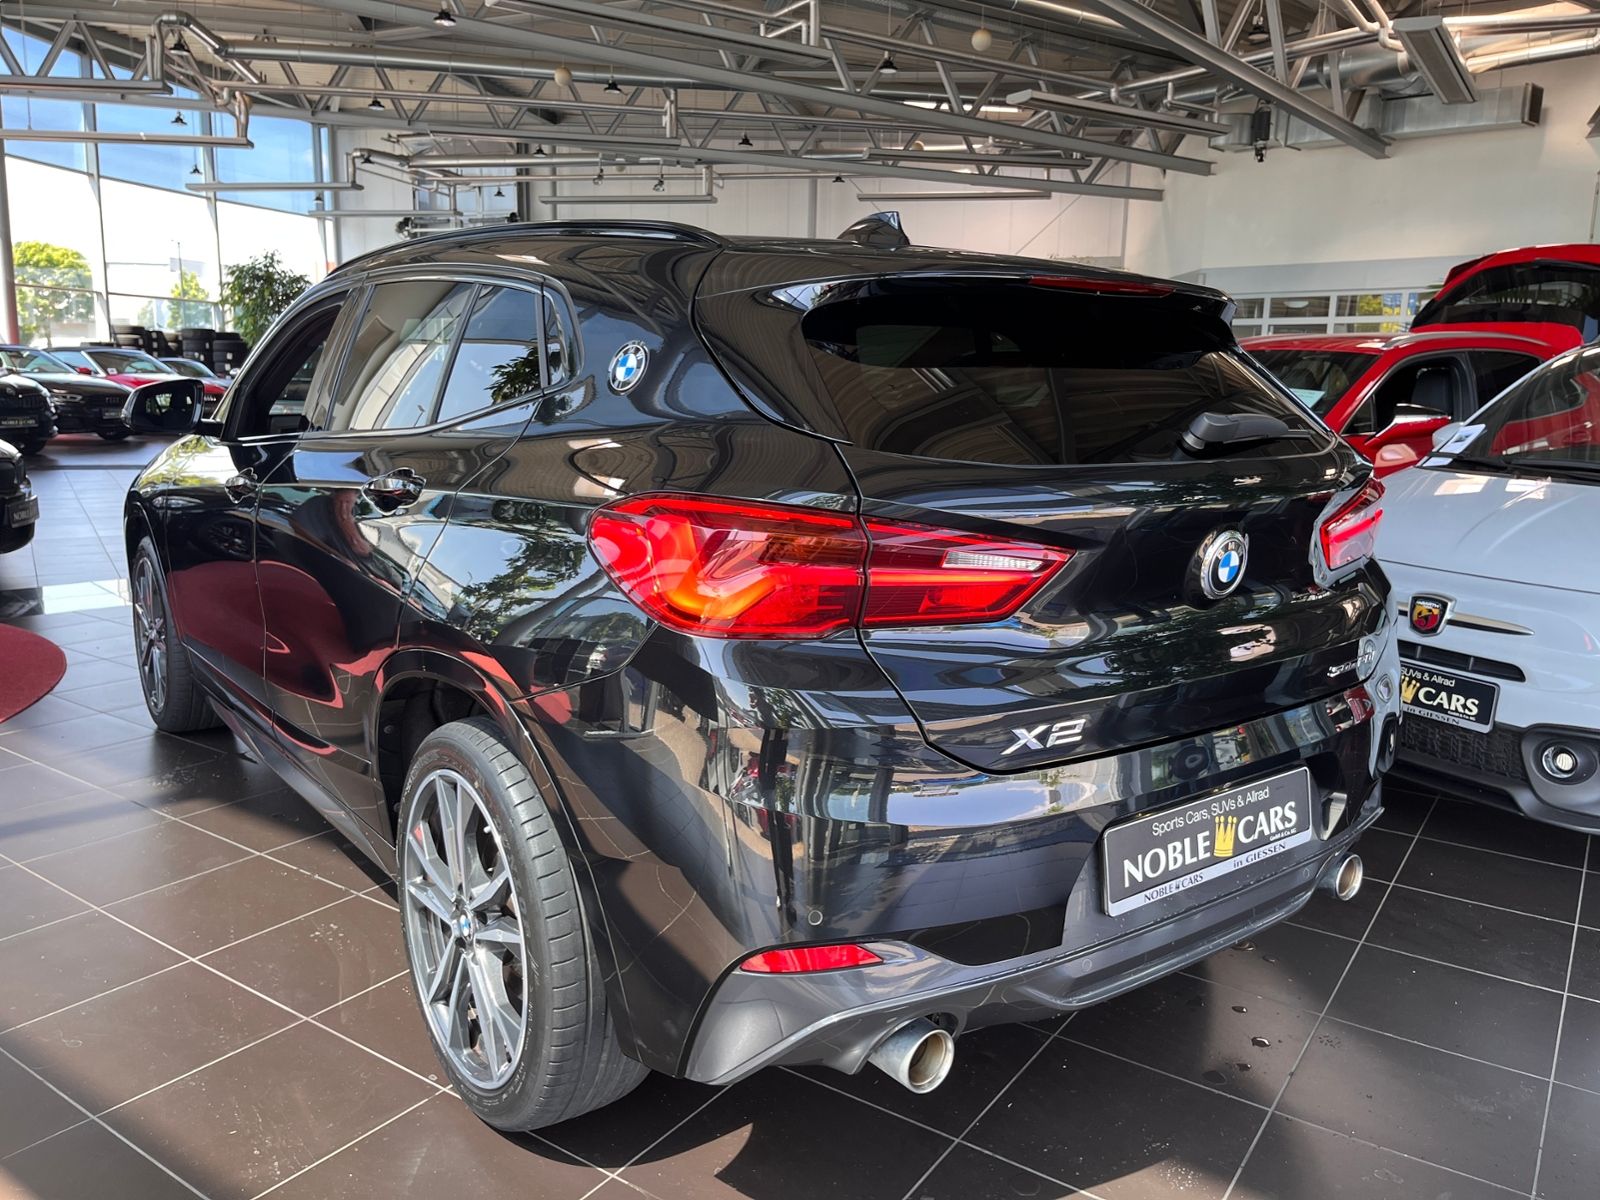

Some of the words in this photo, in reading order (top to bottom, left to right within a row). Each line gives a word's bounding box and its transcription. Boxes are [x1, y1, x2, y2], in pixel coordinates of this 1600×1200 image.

[1422, 672, 1430, 681] &
[1430, 674, 1455, 687] Allrad
[1418, 686, 1479, 716] CARS
[1418, 708, 1460, 725] GIESSEN
[1000, 718, 1086, 755] X2
[1152, 816, 1185, 837] Sports
[1185, 808, 1211, 825] Cars,
[1211, 798, 1236, 816] SUVs
[1236, 794, 1244, 807] &
[1245, 785, 1270, 805] Allrad
[1123, 830, 1211, 888] NOBLE
[1237, 800, 1297, 844] CARS
[1233, 859, 1243, 869] in
[1245, 842, 1287, 863] GIESSEN
[1143, 885, 1173, 904] NOBLE
[1181, 872, 1204, 889] CARS
